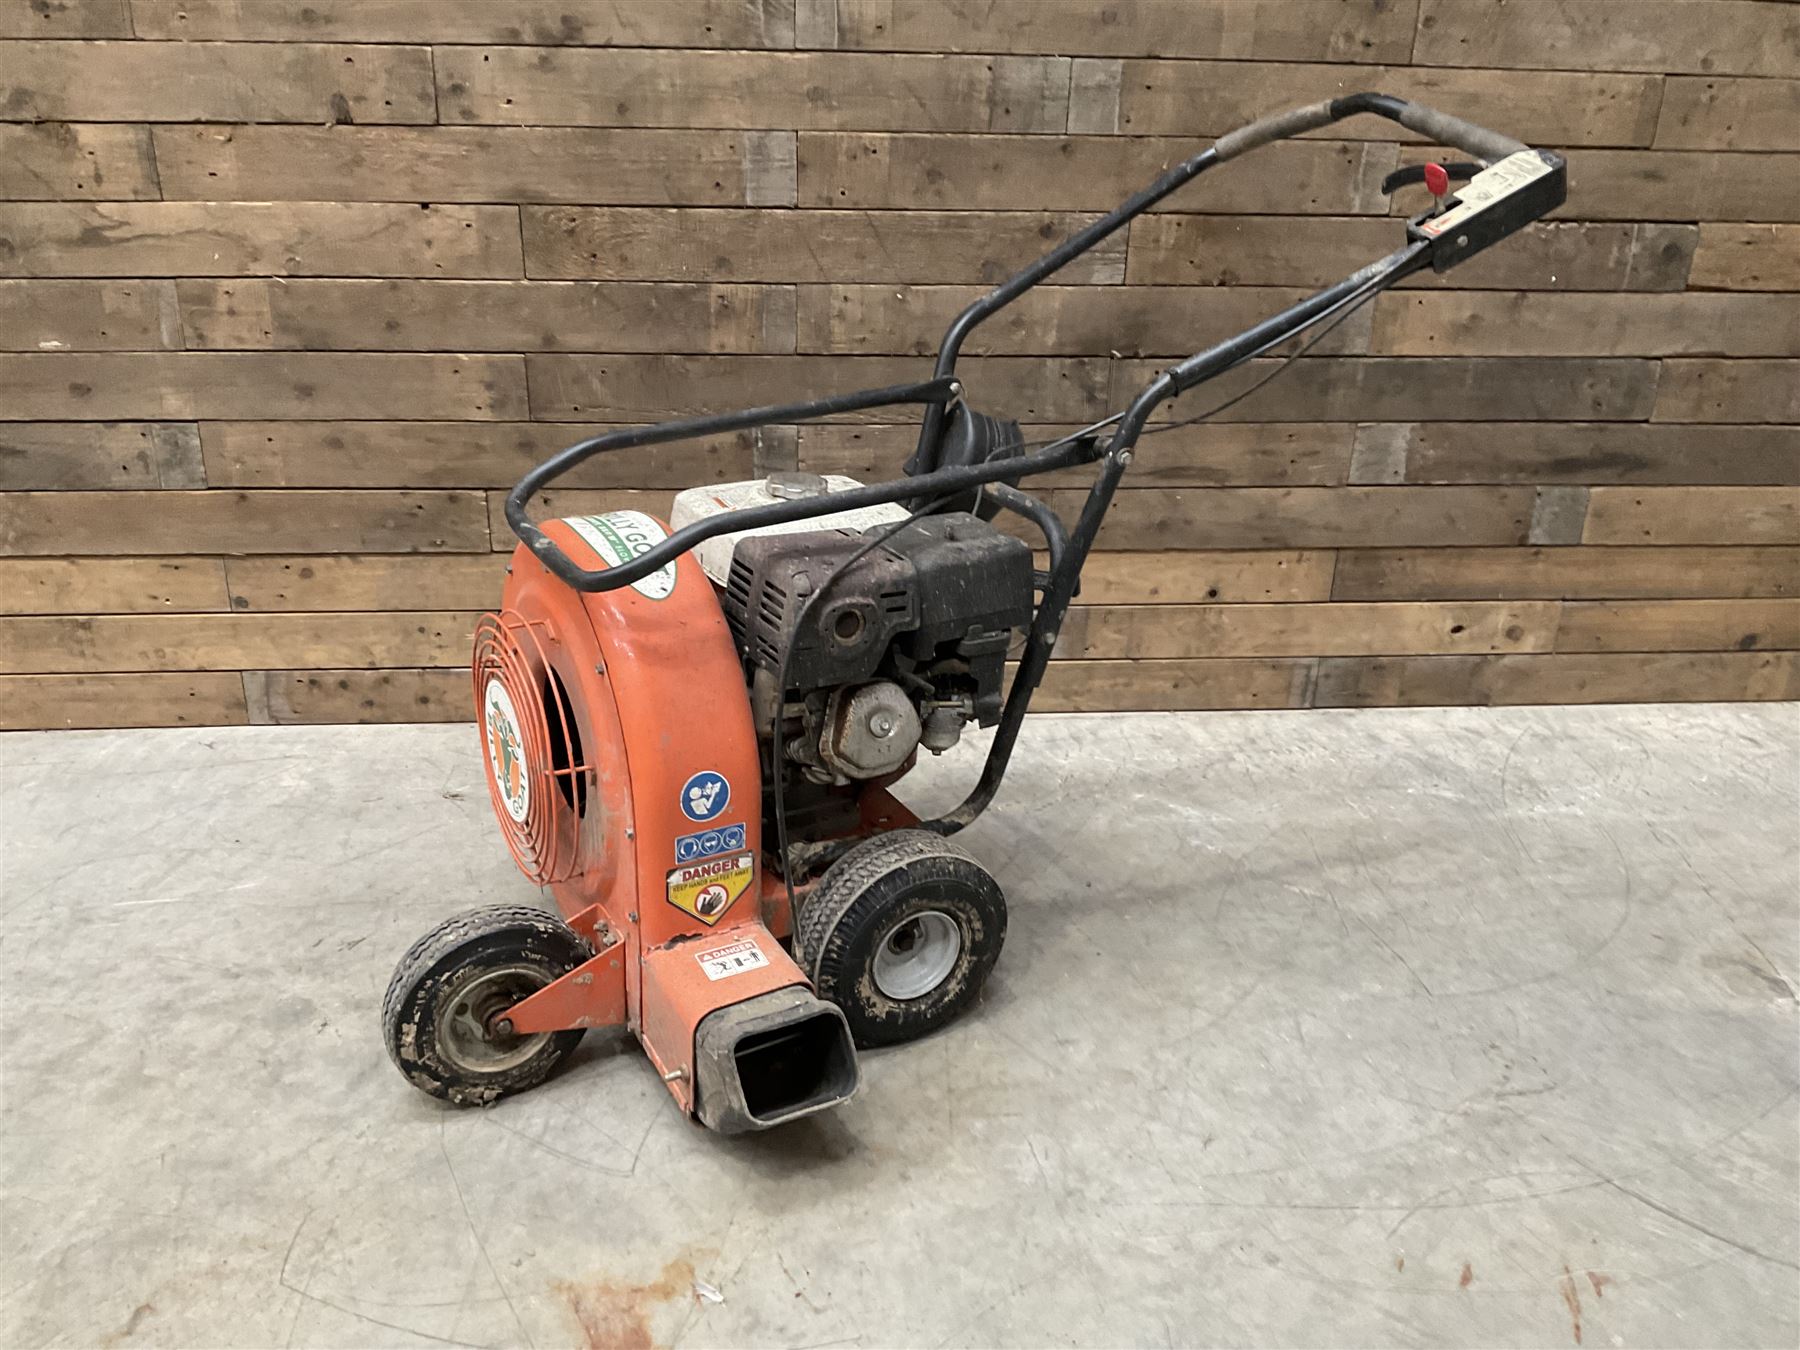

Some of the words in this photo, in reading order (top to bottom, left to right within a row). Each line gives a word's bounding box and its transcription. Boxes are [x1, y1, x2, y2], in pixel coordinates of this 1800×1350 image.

[672, 884, 688, 892] KEEP
[688, 878, 708, 888] HANDS
[719, 871, 733, 880] FEET
[734, 868, 749, 877] AWAY
[682, 858, 740, 882] DANGER
[712, 942, 753, 959] DANGER
